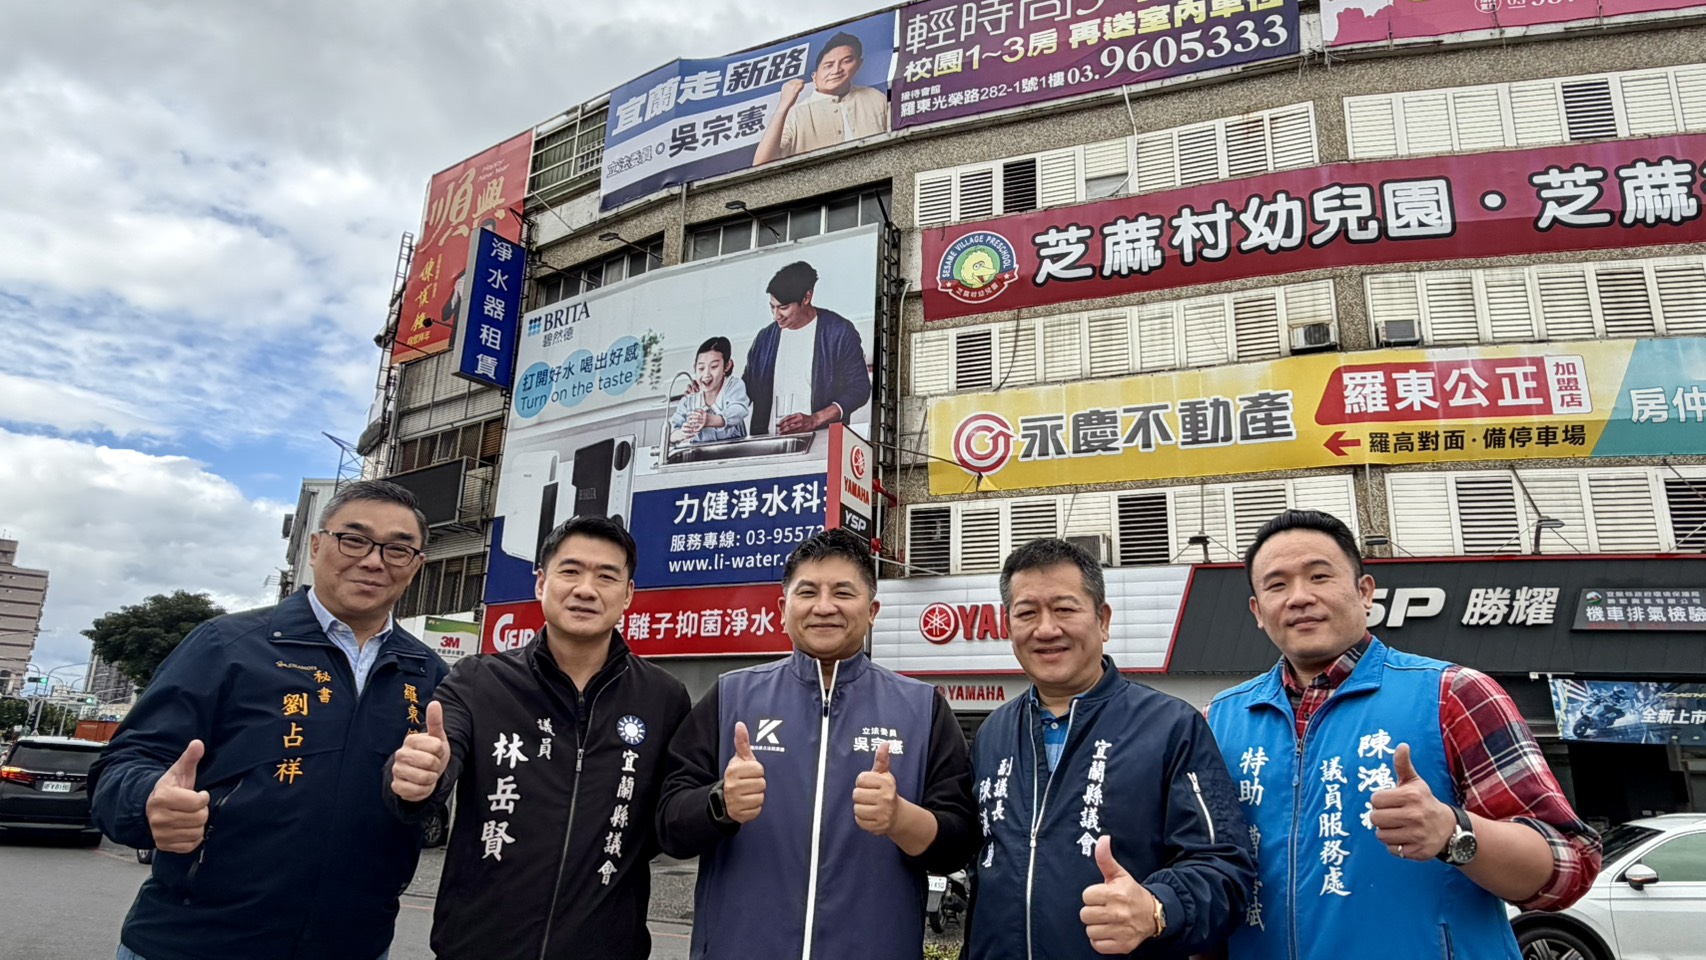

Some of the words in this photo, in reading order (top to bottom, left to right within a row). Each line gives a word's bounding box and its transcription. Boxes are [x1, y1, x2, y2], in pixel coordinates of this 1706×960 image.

[905, 0, 1102, 54] 輕時尚
[903, 29, 1058, 82] 校園1~3房
[612, 46, 807, 136] 宜蘭走新路
[901, 85, 941, 101] 接待會館
[606, 145, 653, 179] 立法委員
[668, 103, 768, 158] 吳宗憲
[942, 251, 958, 277] SESAME
[955, 235, 984, 252] VILLAGE
[986, 236, 1012, 269] PRESCHOOL
[475, 237, 513, 380] 淨水器租賃
[543, 301, 590, 332] BRITA
[542, 327, 575, 348] 碧然德
[522, 363, 575, 392] 打開好水
[580, 342, 639, 374] 喝出好感
[1553, 361, 1583, 409] 加盟店
[521, 394, 548, 411] Turn
[551, 387, 568, 403] on
[572, 380, 594, 397] the
[598, 370, 634, 390] taste
[1342, 364, 1545, 415] 羅東公正
[1020, 391, 1293, 459] 永慶不動產
[673, 480, 827, 526] 力健淨水科
[844, 475, 870, 505] YAMAHA
[670, 530, 740, 553] 服務專線:
[845, 509, 867, 531] YSP
[668, 552, 792, 573] www.li-water.
[615, 607, 788, 646] 離子抑菌淨水
[1461, 586, 1560, 627] 勝耀
[1586, 606, 1706, 623] 機車排氣檢驗
[440, 636, 461, 649] 3M
[313, 669, 333, 704] 秘書
[404, 683, 421, 734] 羅東
[947, 684, 1006, 701] YAMAHA
[862, 727, 898, 738] 立法委員
[1641, 706, 1706, 725] 全新上市
[274, 693, 309, 785] 劉占祥
[536, 718, 556, 760] 議員
[480, 732, 529, 861] 林岳賢
[991, 756, 1013, 822] 副議長
[1077, 739, 1112, 857] 宜蘭縣議會
[1238, 747, 1269, 807] 特助
[598, 749, 640, 886] 宜蘭縣議會
[1318, 759, 1351, 897] 議員服務處
